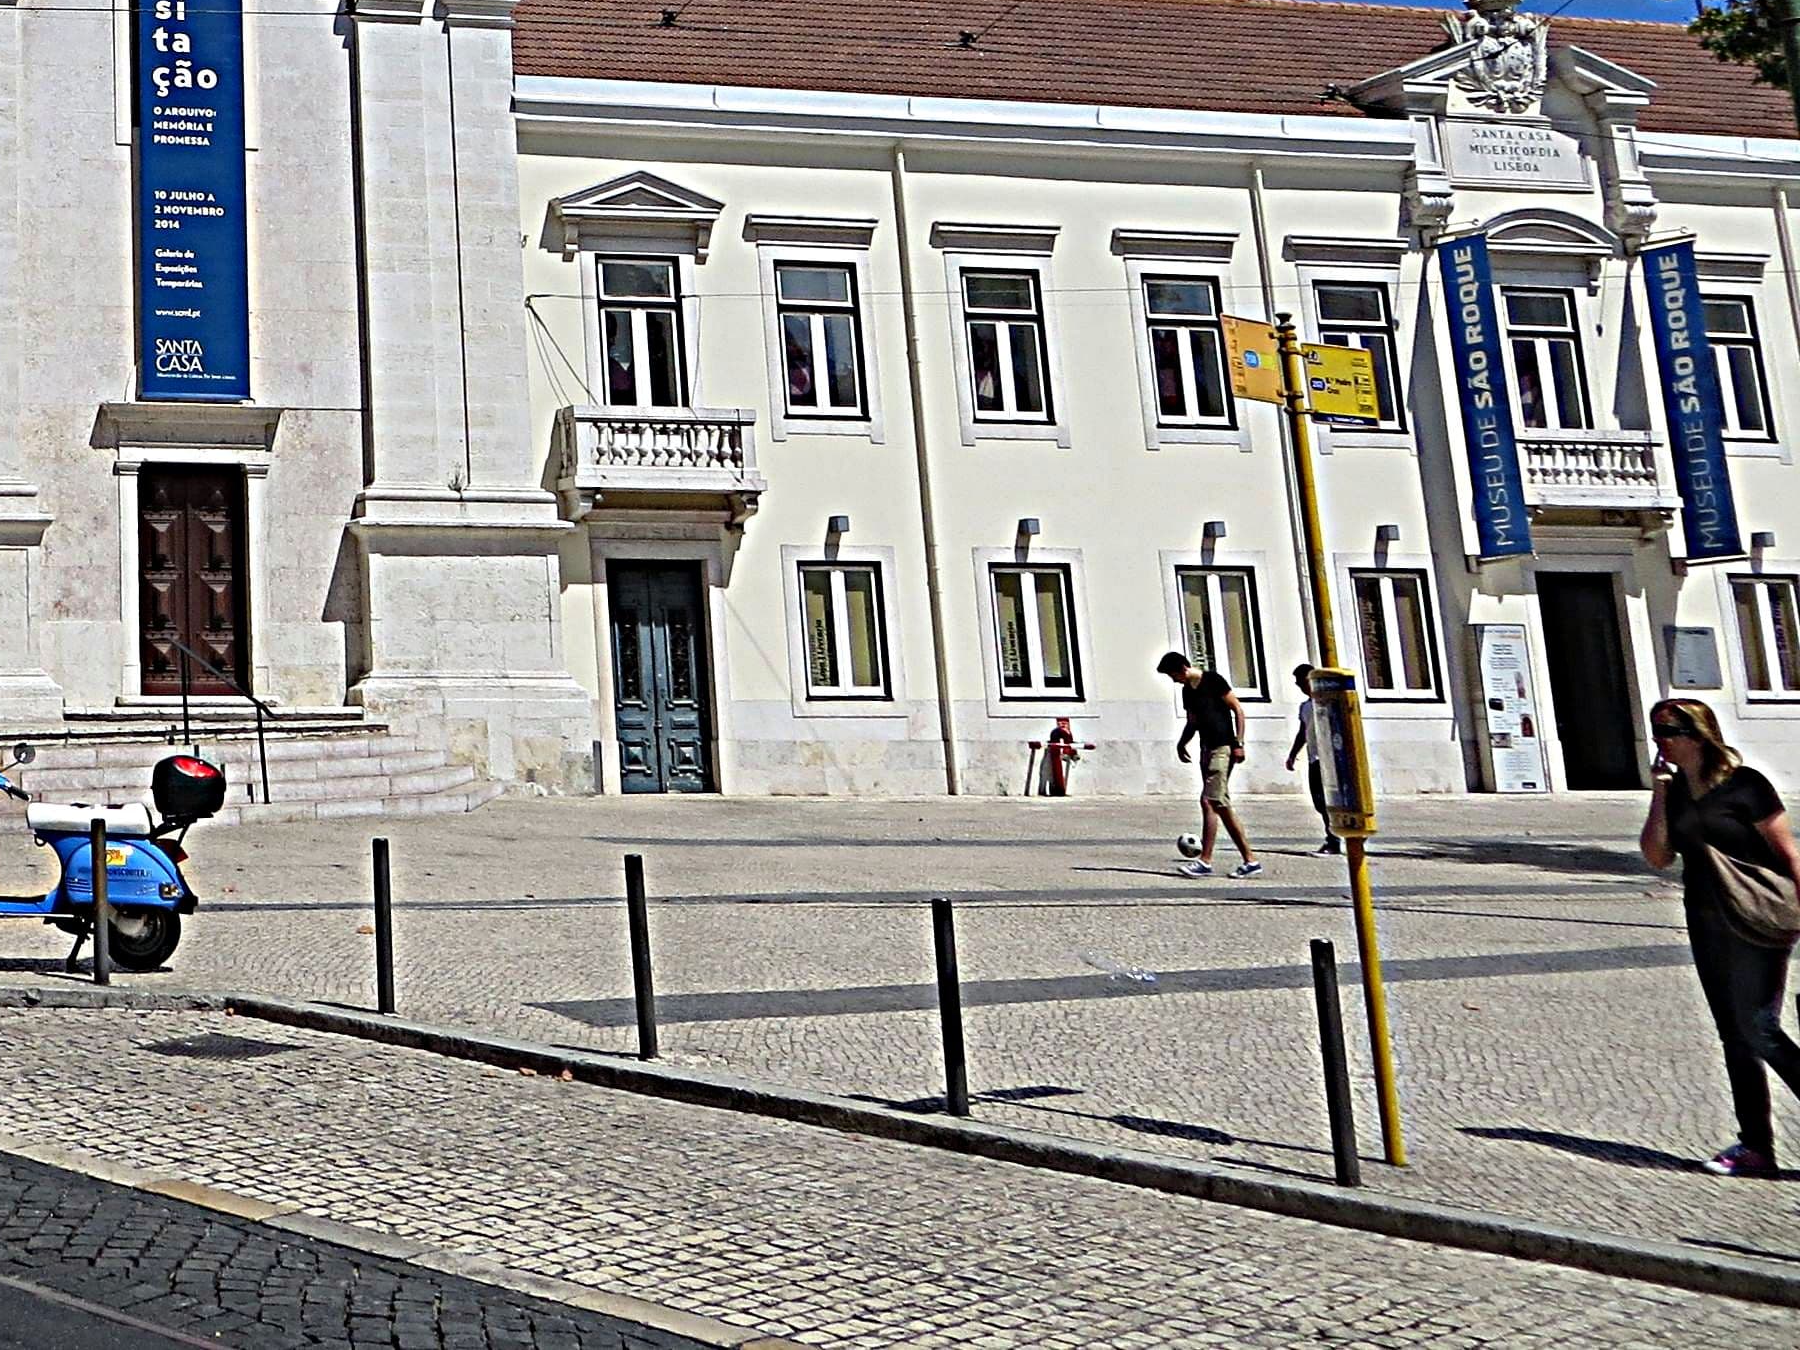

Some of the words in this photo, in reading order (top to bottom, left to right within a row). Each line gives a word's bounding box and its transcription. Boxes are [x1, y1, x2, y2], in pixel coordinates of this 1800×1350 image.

[153, 106, 162, 115] O
[164, 106, 217, 118] ARQUIVO:
[153, 120, 205, 132] MEMÓRIA
[206, 122, 214, 132] E
[153, 134, 211, 146] PROMESSA
[1471, 128, 1513, 140] SANTA
[1518, 130, 1552, 142] CASA
[1494, 161, 1540, 172] LISBOA
[154, 190, 167, 200] 10
[169, 191, 205, 201] JULHO
[207, 193, 215, 202] A
[154, 204, 161, 214] 2
[163, 205, 224, 216] NOVEMBRO
[154, 219, 180, 229] 2014
[1454, 246, 1485, 343] ROQUE
[1659, 252, 1691, 350] ROQUE
[155, 338, 203, 355] SANTA
[155, 354, 203, 372] CASA
[1466, 351, 1494, 410] SÃO
[1672, 355, 1701, 415] SÃO
[1477, 414, 1503, 451] DE
[1684, 417, 1708, 453] DE
[1484, 454, 1513, 546] MUSEU
[1691, 457, 1724, 549] MUSEU
